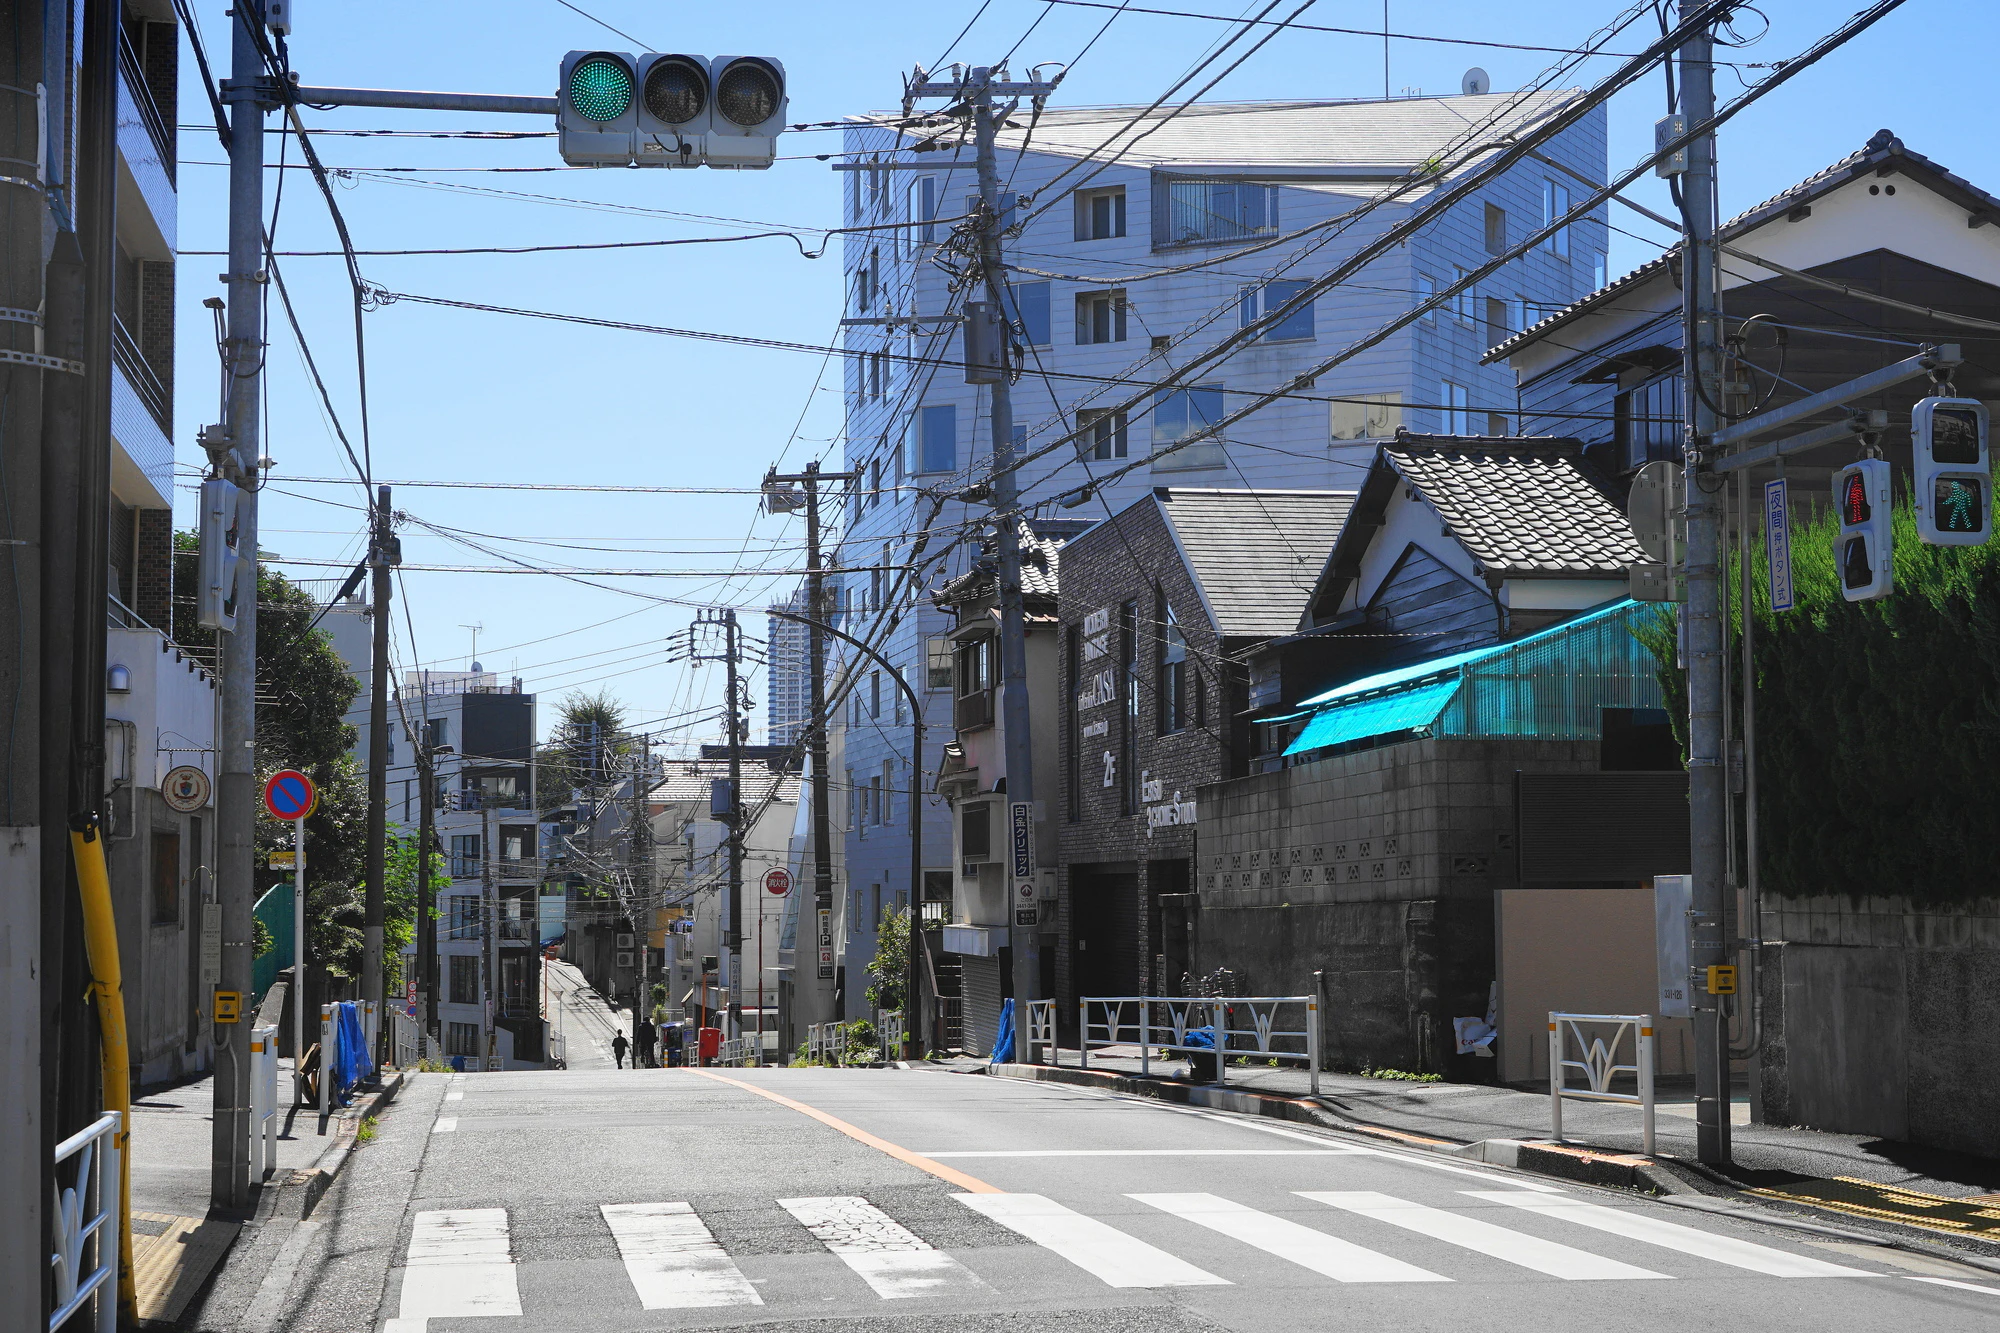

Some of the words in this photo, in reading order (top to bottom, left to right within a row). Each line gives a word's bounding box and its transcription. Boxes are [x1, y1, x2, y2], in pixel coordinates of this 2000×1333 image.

[1770, 489, 1786, 601] 夜間押ボタン式
[1103, 750, 1116, 787] 2F
[1015, 806, 1027, 875] 白金クリニック
[768, 878, 787, 888] 消火栓
[821, 935, 830, 946] P
